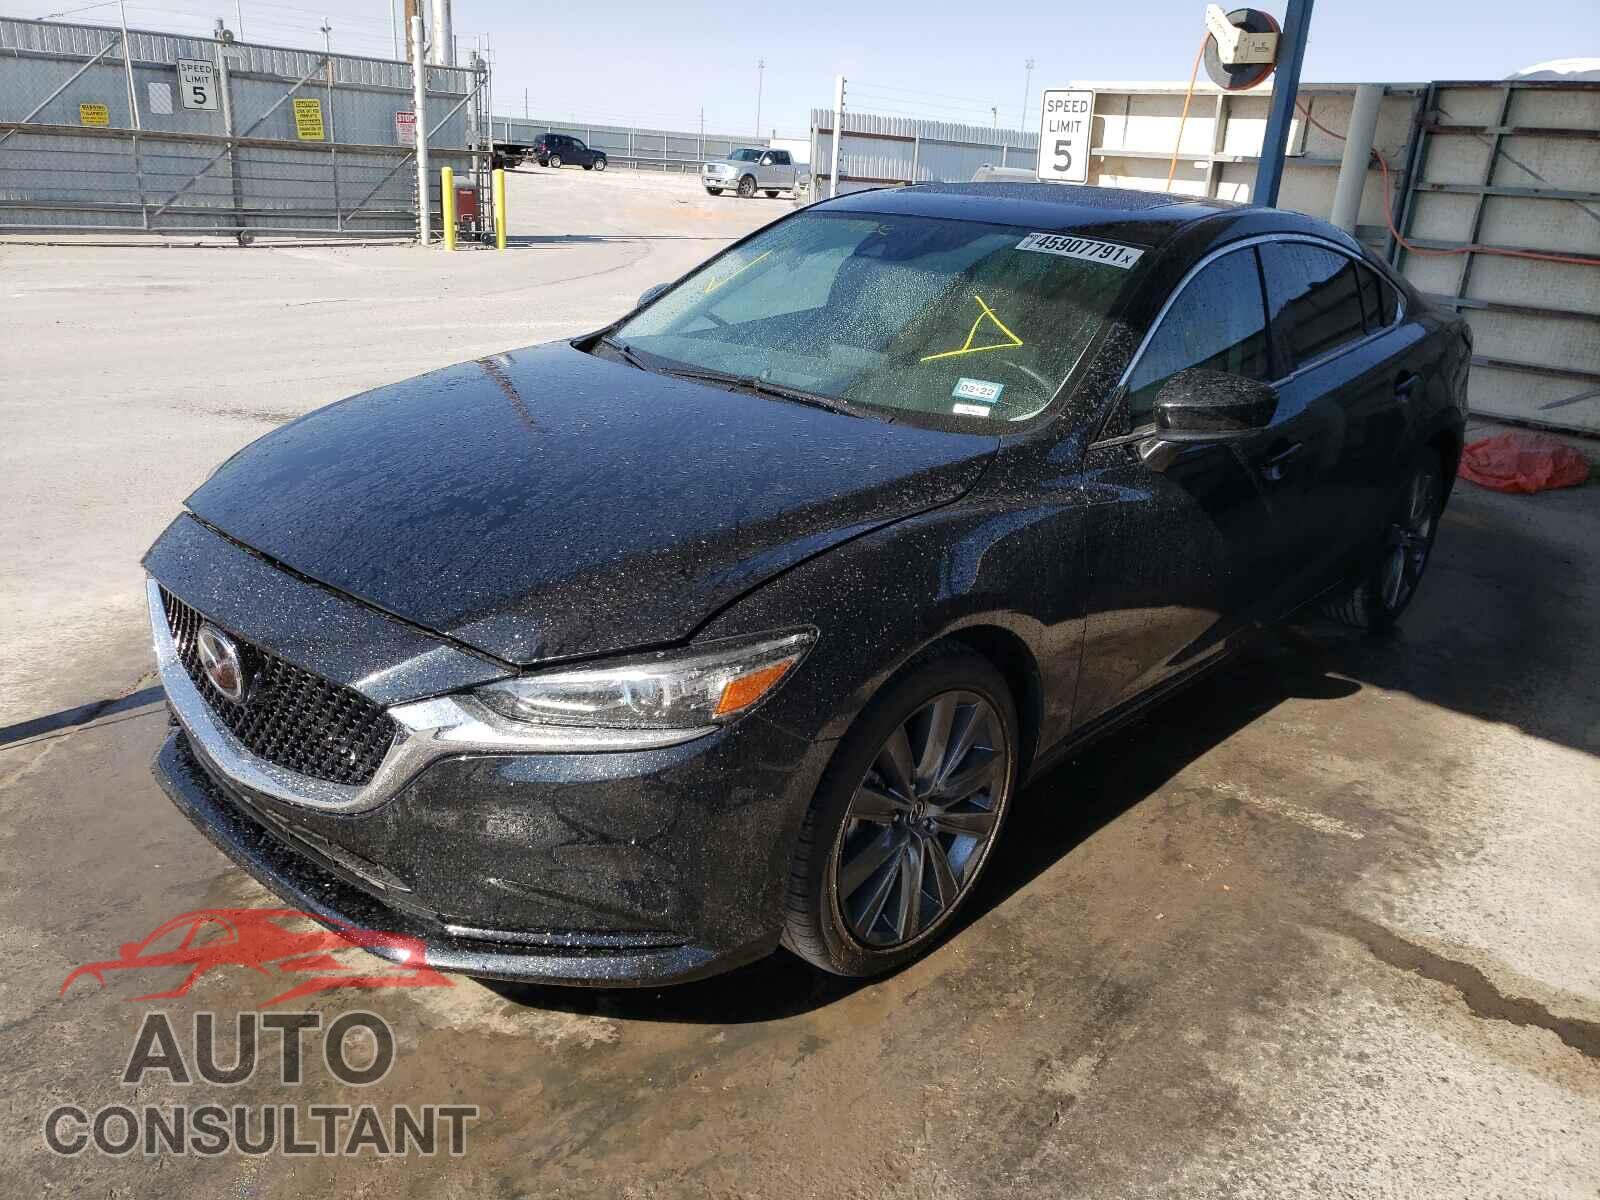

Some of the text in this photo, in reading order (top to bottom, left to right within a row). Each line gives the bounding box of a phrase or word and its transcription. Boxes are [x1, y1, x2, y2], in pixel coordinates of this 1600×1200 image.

[181, 64, 212, 73] SPEED
[185, 75, 208, 83] LIMIT
[192, 86, 207, 105] 5
[1047, 99, 1088, 113] SPEED
[1049, 119, 1082, 133] LIMIT
[1052, 139, 1072, 172] 5
[1035, 235, 1126, 262] 45907791
